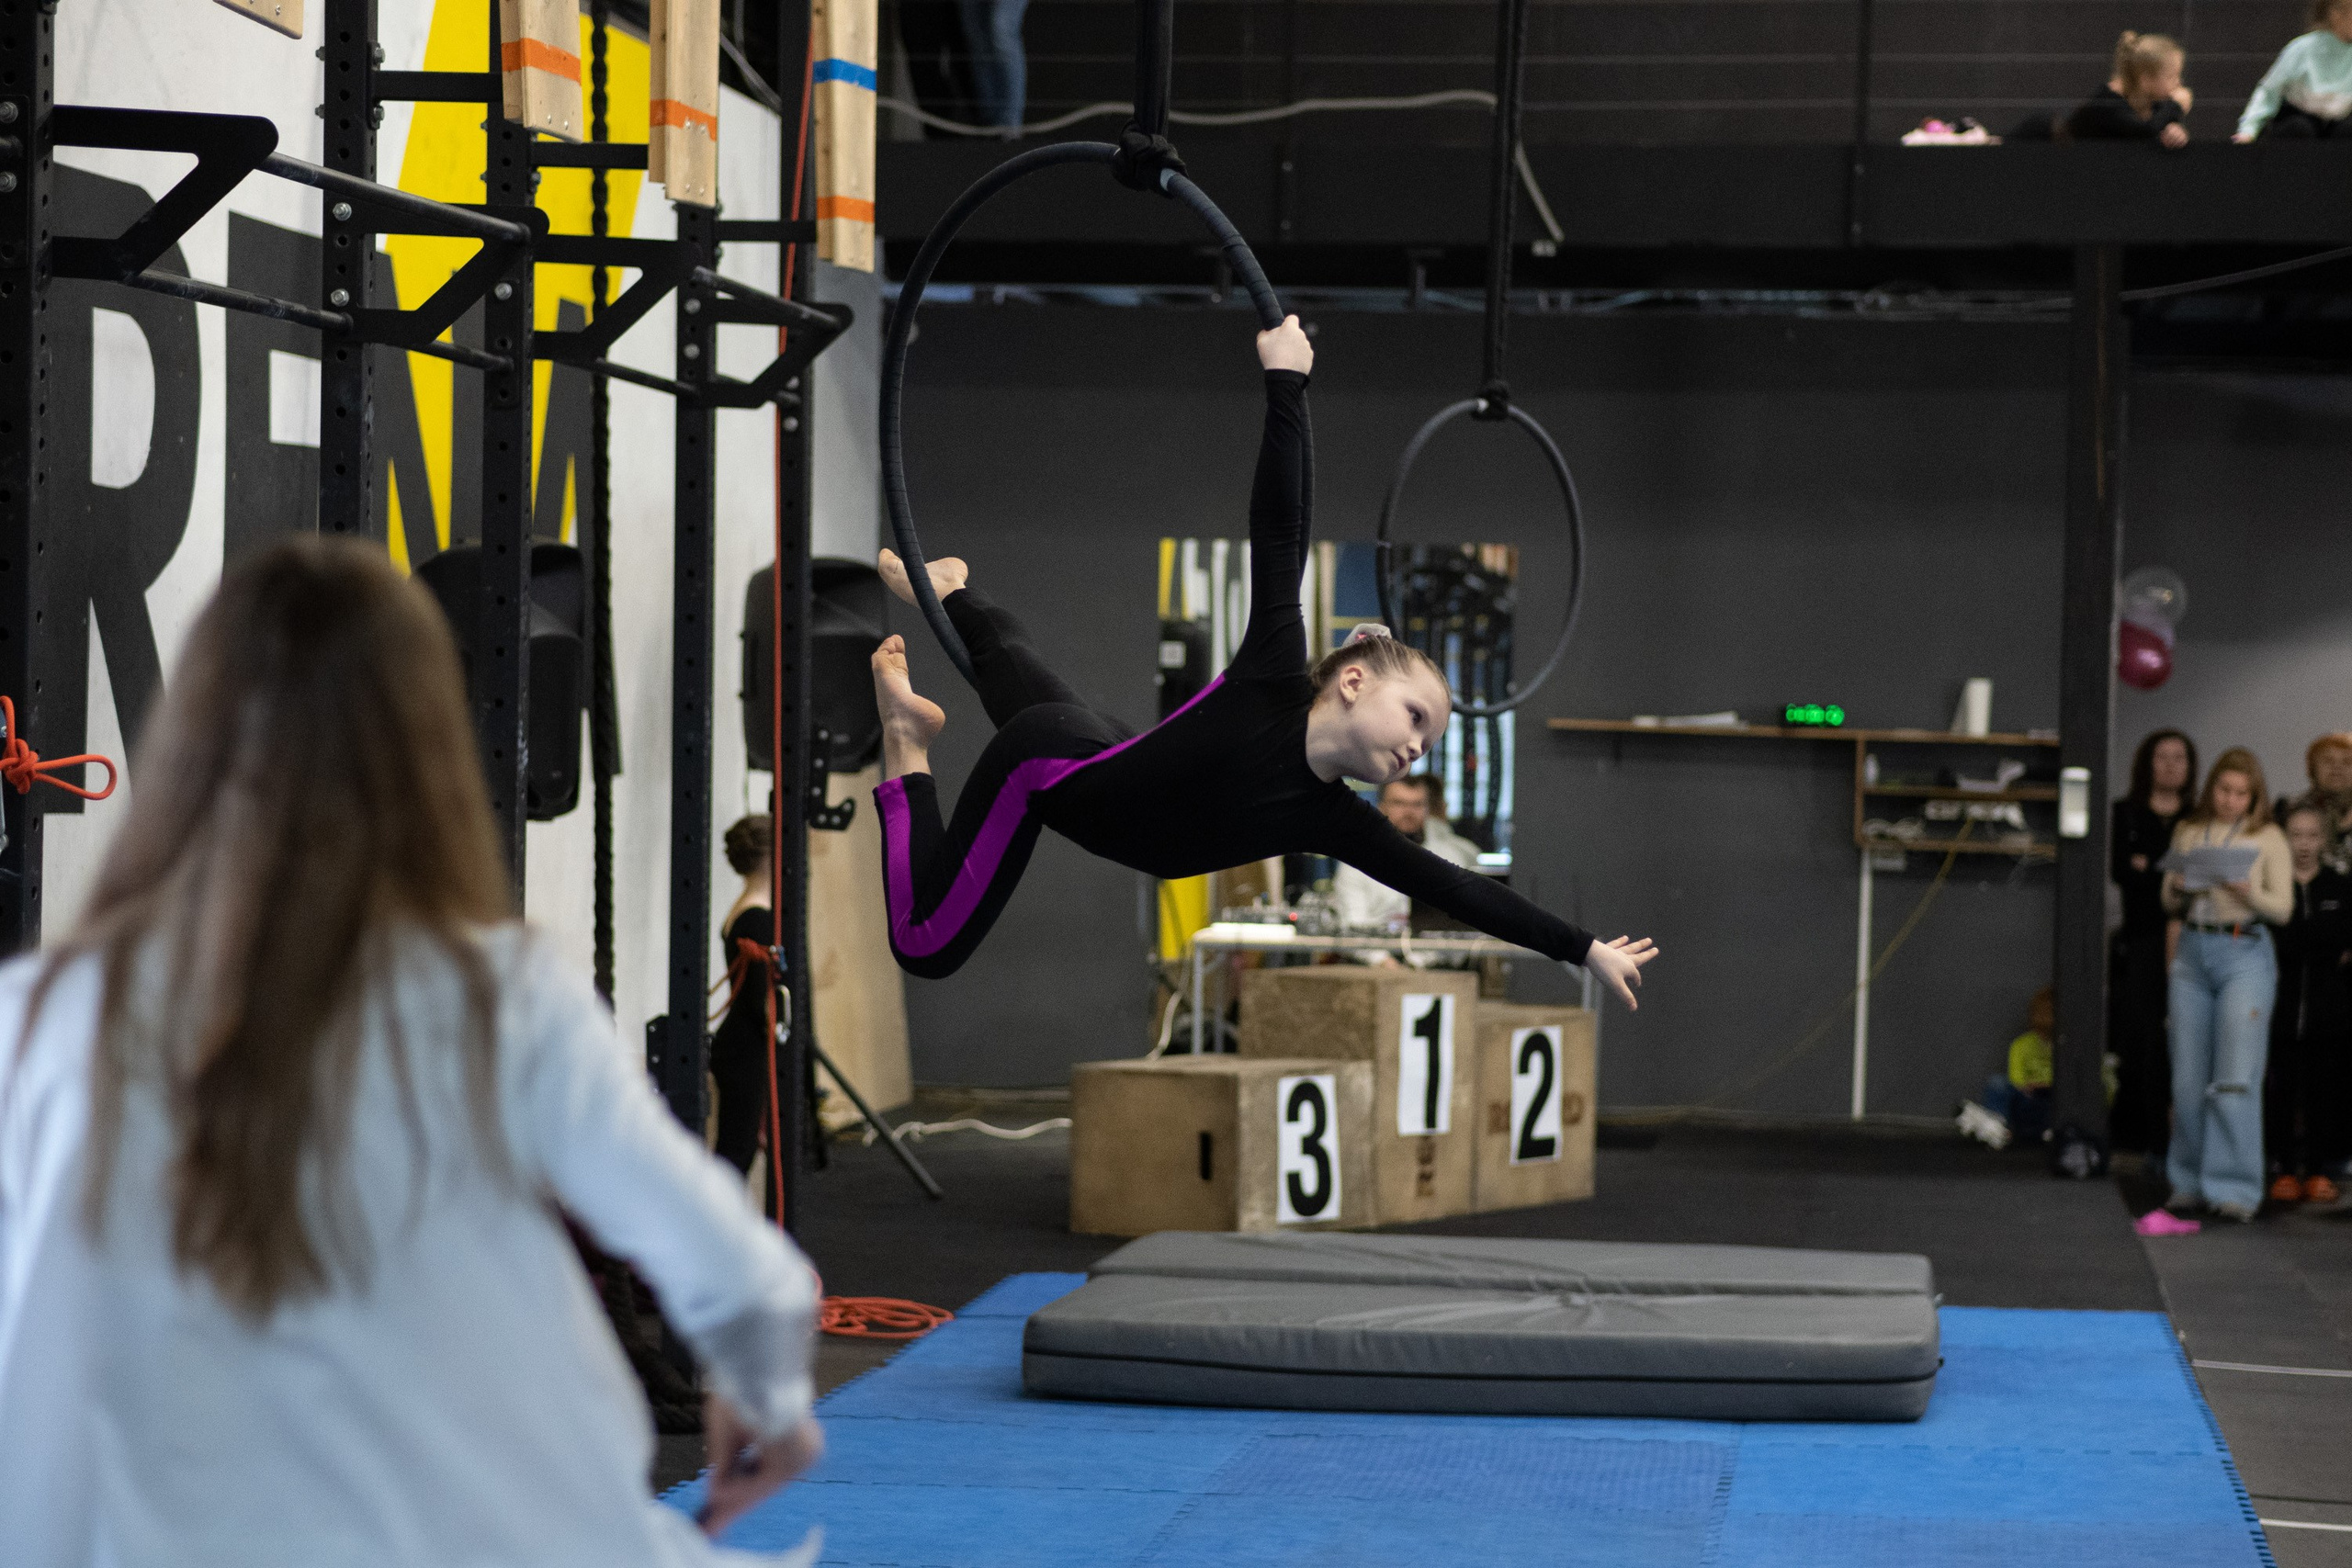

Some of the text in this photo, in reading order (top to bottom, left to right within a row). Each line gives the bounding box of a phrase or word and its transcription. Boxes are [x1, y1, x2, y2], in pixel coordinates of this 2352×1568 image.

[1413, 996, 1442, 1130] 1
[1516, 1030, 1556, 1162] 2
[1286, 1080, 1332, 1217] 3
